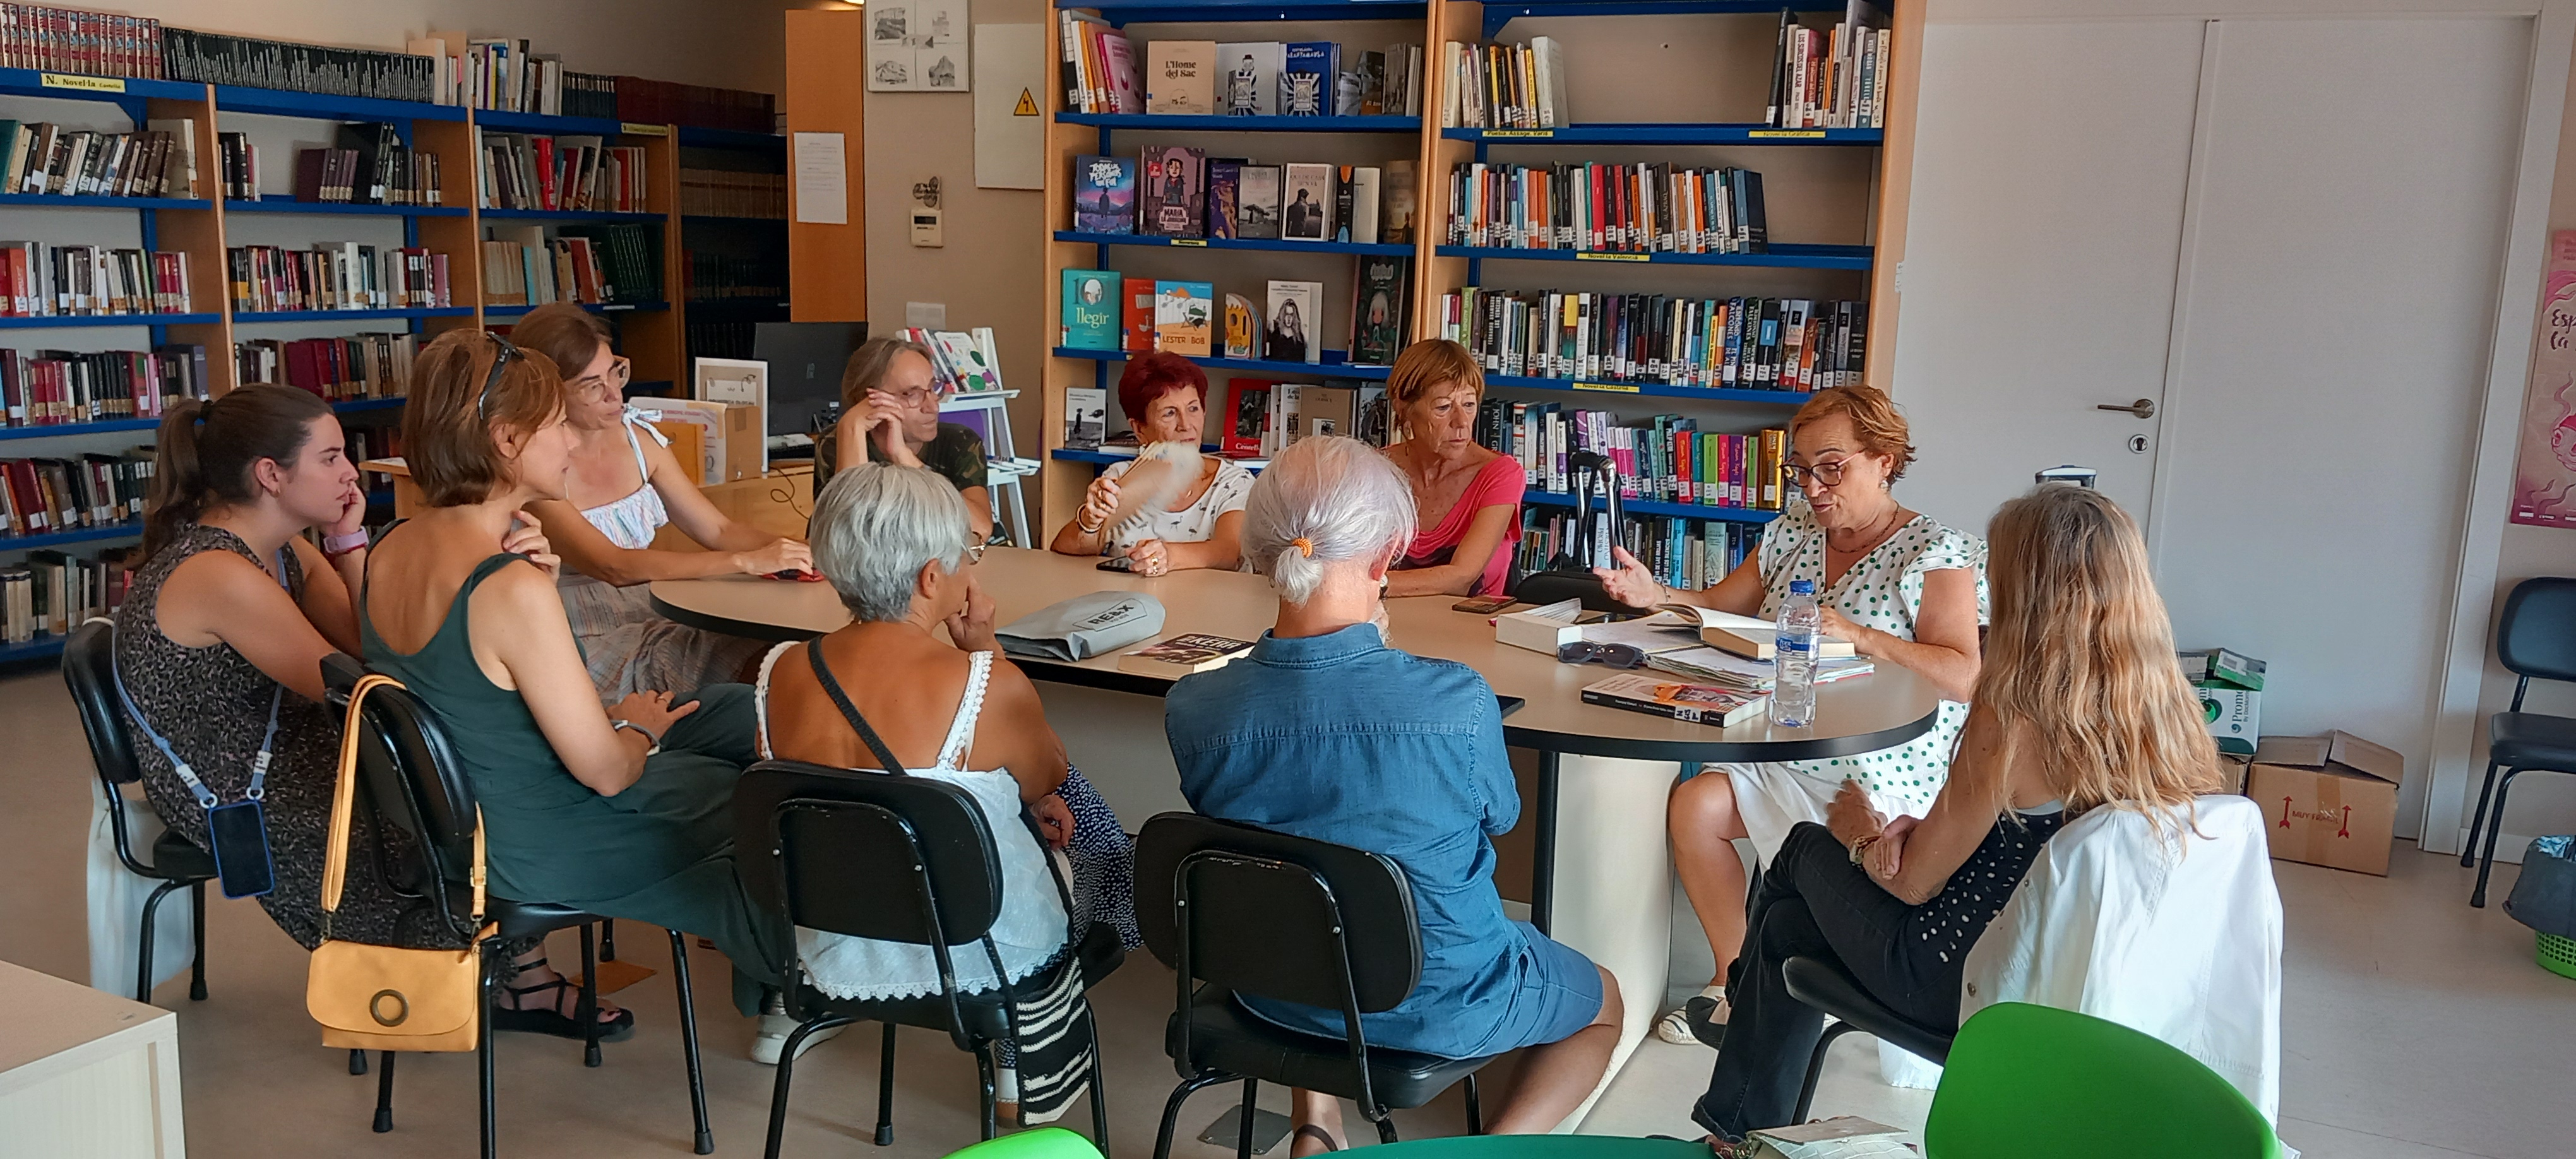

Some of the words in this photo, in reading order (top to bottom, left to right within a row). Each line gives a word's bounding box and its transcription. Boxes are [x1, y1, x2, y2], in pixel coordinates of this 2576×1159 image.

[1166, 69, 1178, 80] del
[1180, 69, 1196, 78] Sac
[1076, 307, 1109, 329] llegir
[1727, 303, 1736, 340] FALCONES
[1746, 306, 1755, 340] FALCONES
[1162, 336, 1186, 344] LESTER
[1191, 336, 1205, 344] BOB
